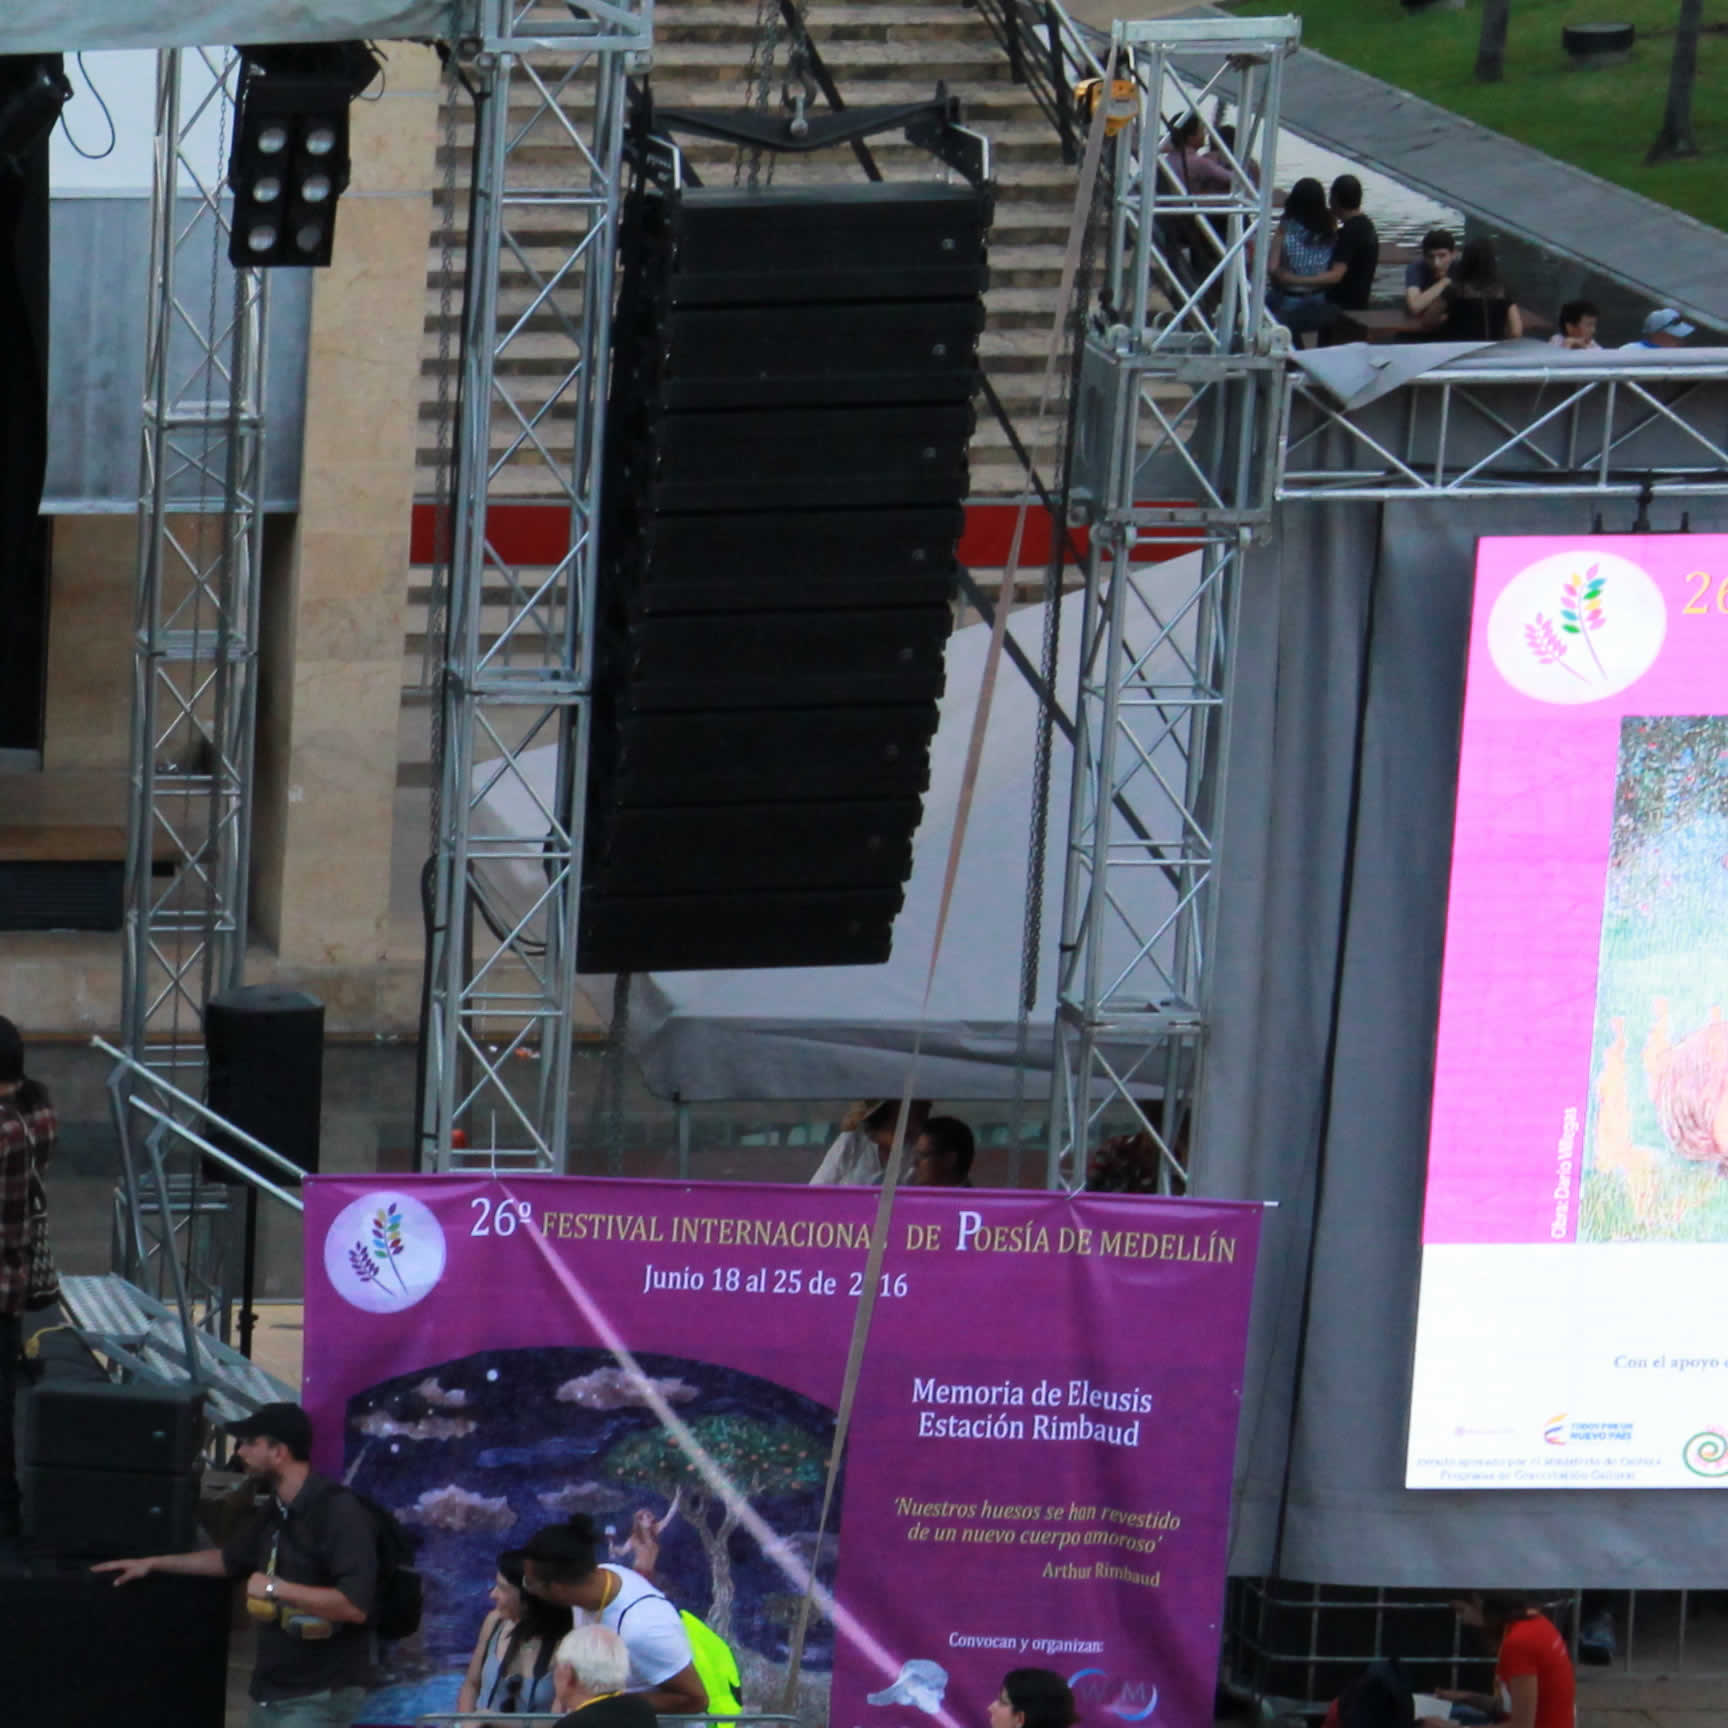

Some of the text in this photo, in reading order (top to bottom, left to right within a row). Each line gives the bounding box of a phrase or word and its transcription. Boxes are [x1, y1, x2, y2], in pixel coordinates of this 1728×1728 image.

[470, 1197, 1236, 1263] 26º FESTIVAL INTERNACIONA DE POESÍA DE MEDELLÍN
[643, 1264, 908, 1297] Junio 18 al 25 de 216
[1613, 1354, 1719, 1373] Con el apoyo
[912, 1377, 1153, 1413] Memoria de Eleusis
[919, 1411, 1140, 1447] Estación Rimbaud
[981, 1500, 1041, 1520] huesos
[1046, 1505, 1064, 1520] se
[1068, 1502, 1097, 1520] han
[1101, 1506, 1181, 1531] revestido
[908, 1522, 930, 1541] de
[934, 1527, 956, 1541] un
[961, 1528, 1016, 1545] nuevo
[1020, 1530, 1081, 1550] cuerpo
[1043, 1561, 1161, 1587] Arthur Rimbaud
[949, 1632, 1104, 1655] Convocan y organizan:
